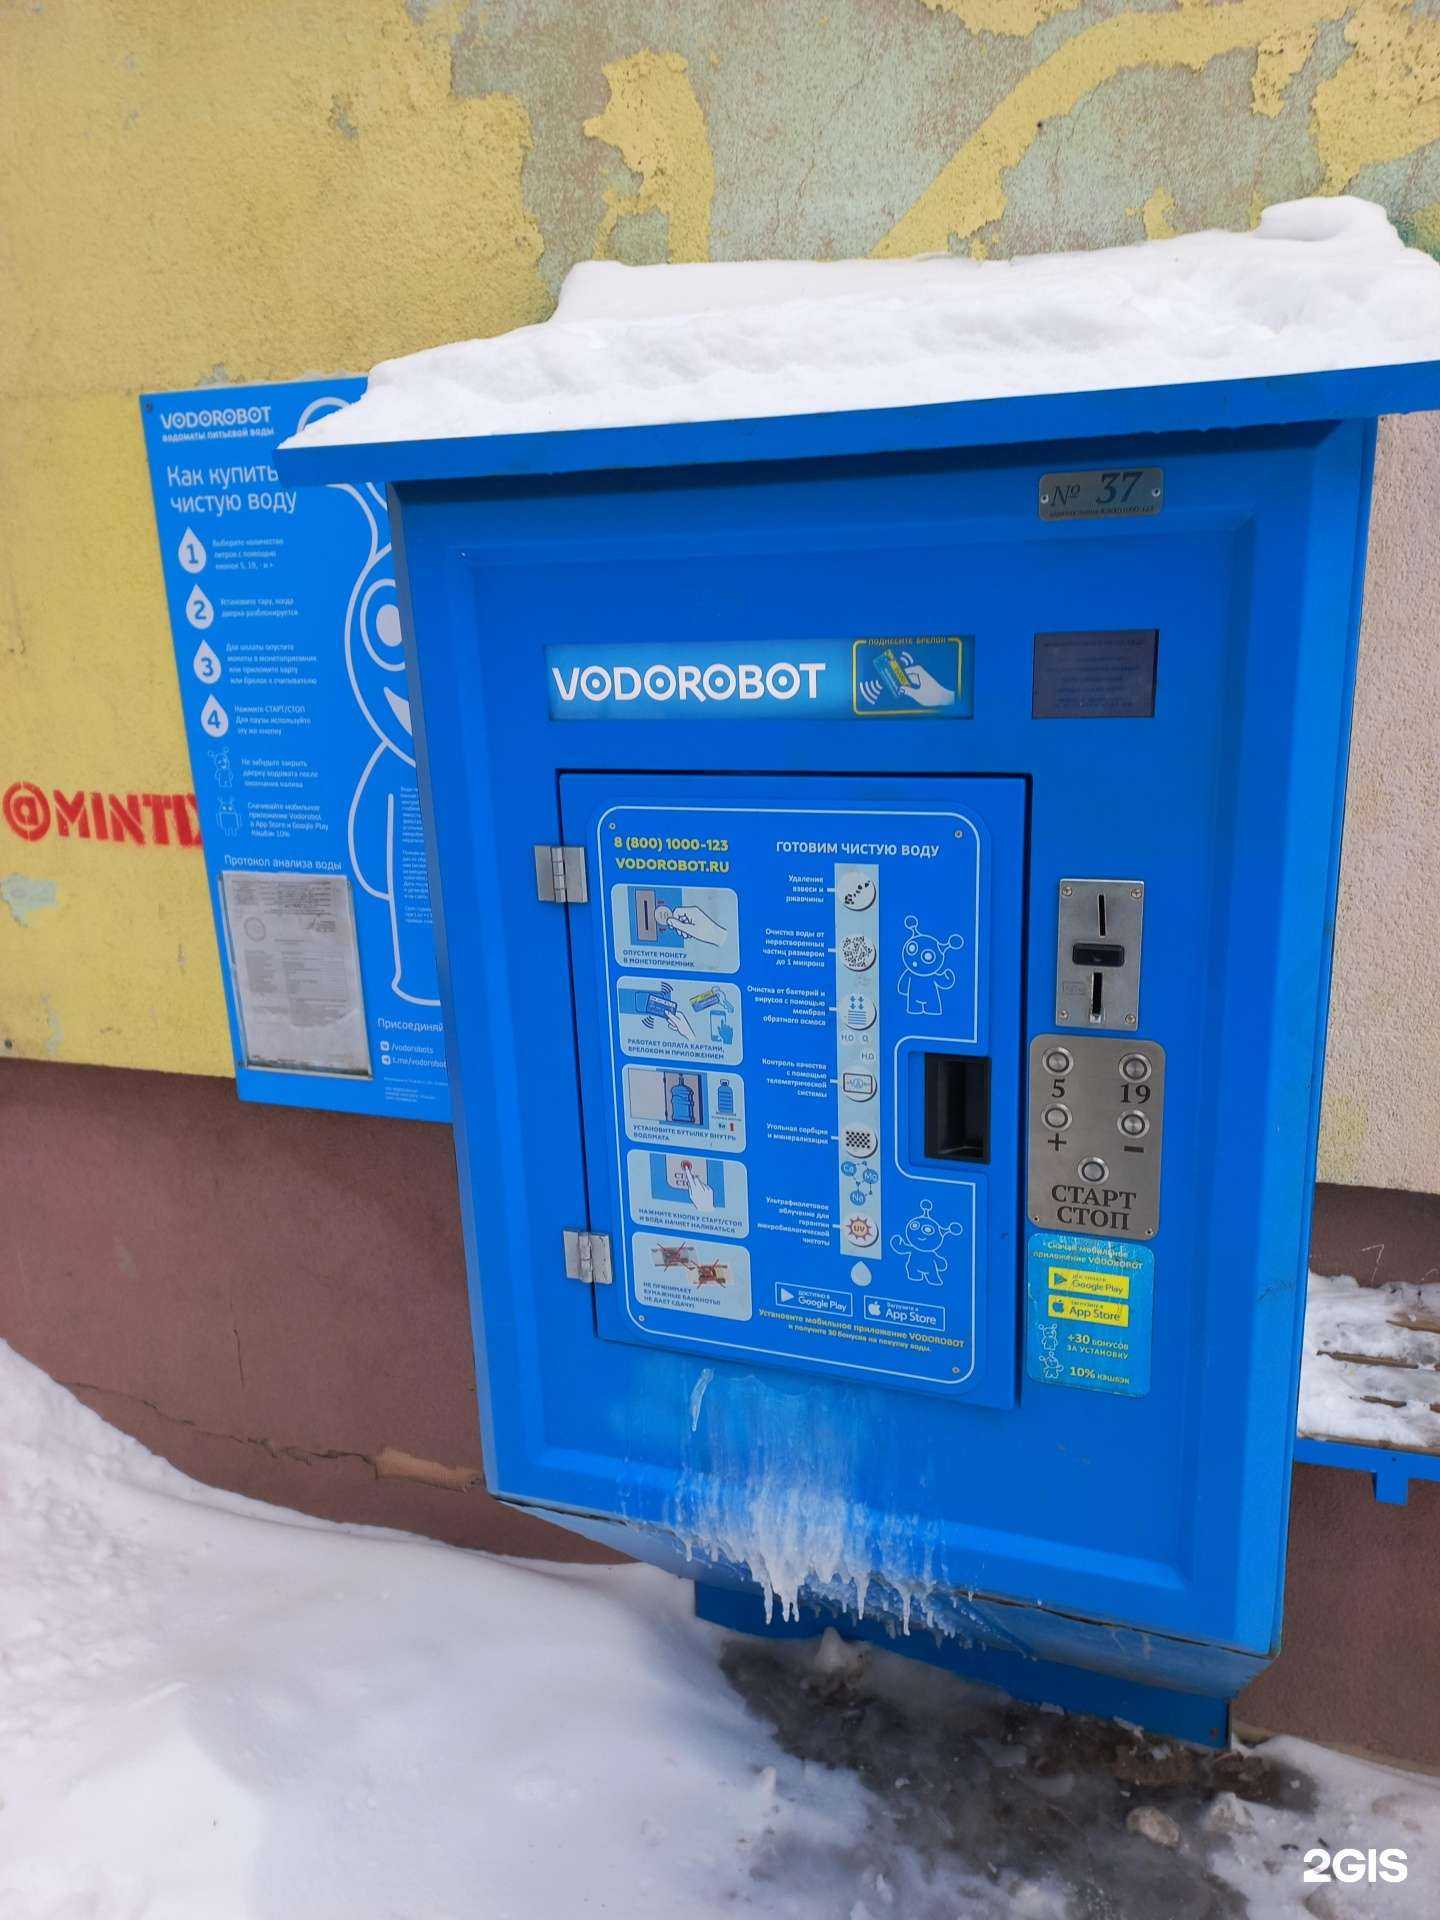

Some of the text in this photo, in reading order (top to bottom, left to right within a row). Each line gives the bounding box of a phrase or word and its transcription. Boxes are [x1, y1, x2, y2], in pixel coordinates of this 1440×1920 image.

[160, 406, 271, 429] VODOROBOT
[167, 465, 279, 490] Как купить
[1096, 472, 1144, 504] 37
[170, 491, 297, 517] чистую воду
[187, 543, 198, 564] 1
[194, 600, 206, 620] 2
[201, 657, 214, 677] 3
[552, 662, 826, 702] VODOROBOT
[207, 710, 220, 729] 4
[614, 836, 729, 852] 8 (800) 1000-123
[776, 841, 939, 859] ГОТОВИМ ЧИСТУЮ ВОДУ
[224, 854, 342, 871] Протокол анализа воды
[616, 858, 730, 873] VODOROBOT.RU
[788, 874, 824, 883] Удаление
[766, 928, 794, 937] Очистка
[796, 930, 815, 938] воды
[747, 984, 776, 994] Очистка
[1052, 1078, 1151, 1104] 5 19
[1052, 1184, 1136, 1210] СТАРТ
[1057, 1206, 1130, 1230] СТОП
[798, 1296, 848, 1312] Google Play
[885, 1309, 937, 1325] App Store
[1069, 1306, 1120, 1321] App Store
[910, 1332, 966, 1348] VODOROBOT
[1067, 1334, 1090, 1344] +30
[1069, 1366, 1096, 1378] 10%
